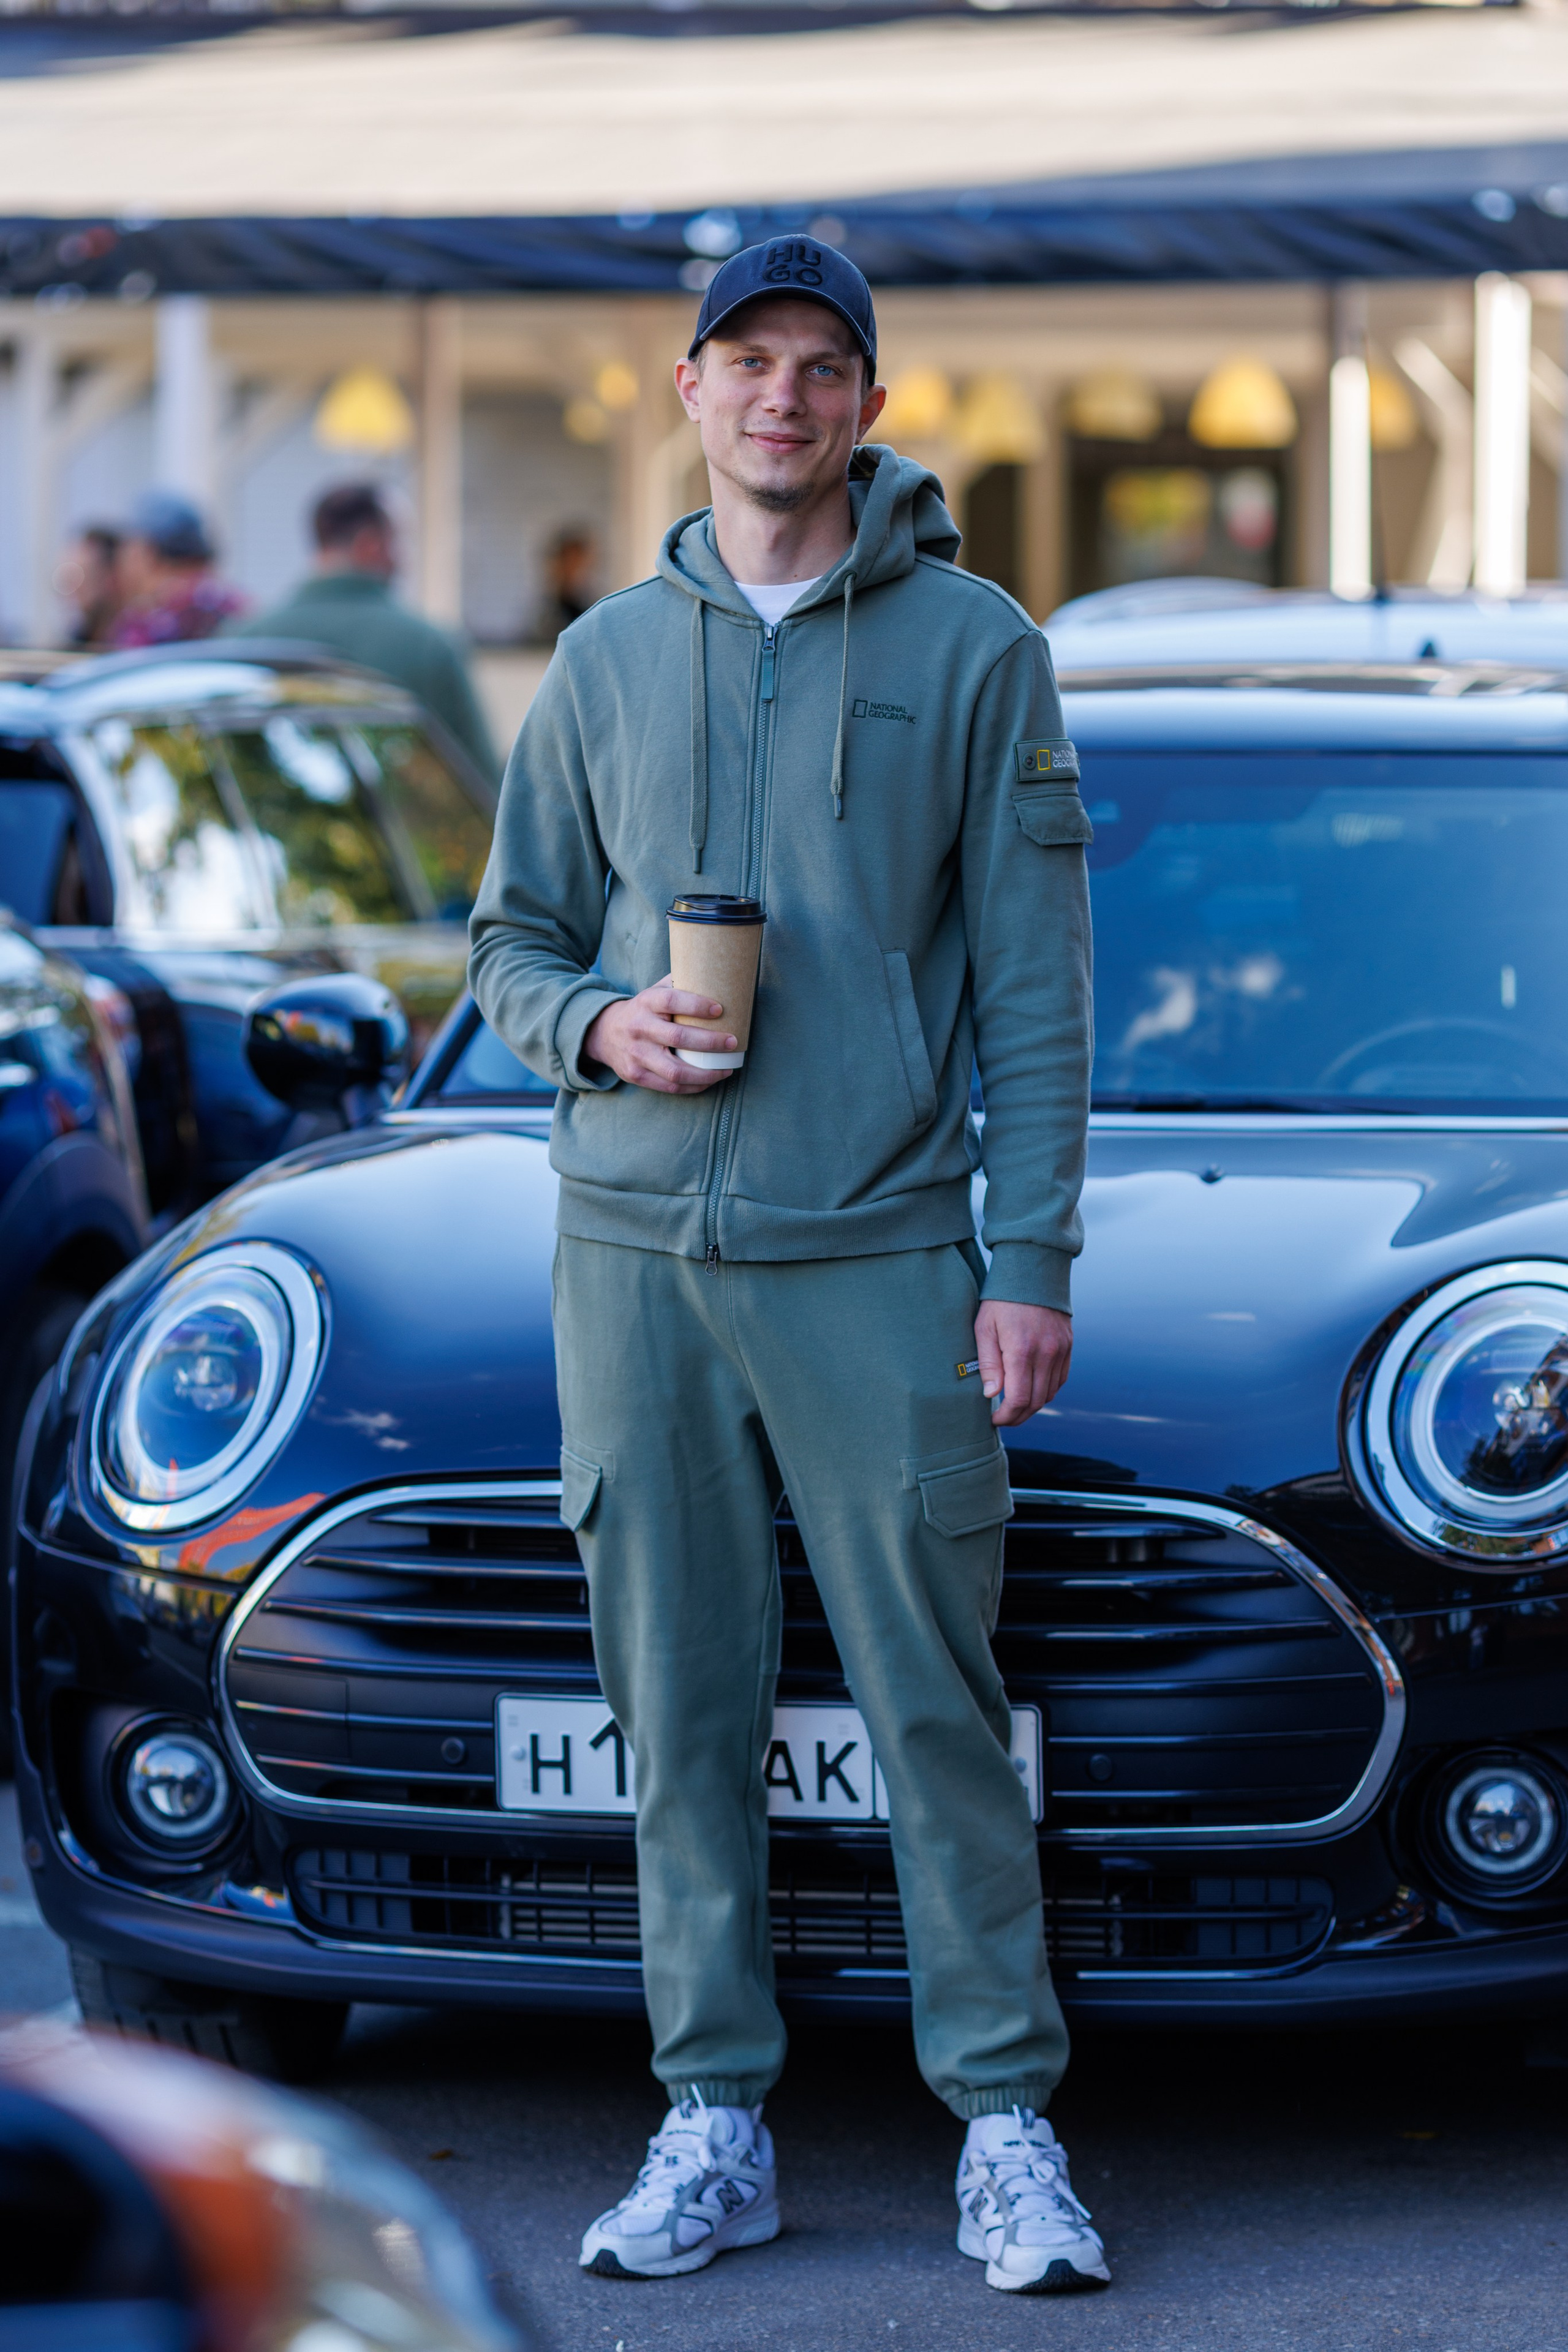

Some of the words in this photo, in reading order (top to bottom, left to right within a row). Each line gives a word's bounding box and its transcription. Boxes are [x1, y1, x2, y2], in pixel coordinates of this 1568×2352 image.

[767, 244, 821, 266] HU
[763, 264, 823, 285] GO
[870, 702, 908, 714] NATIONAL
[869, 710, 917, 724] GEOGRAPHIC
